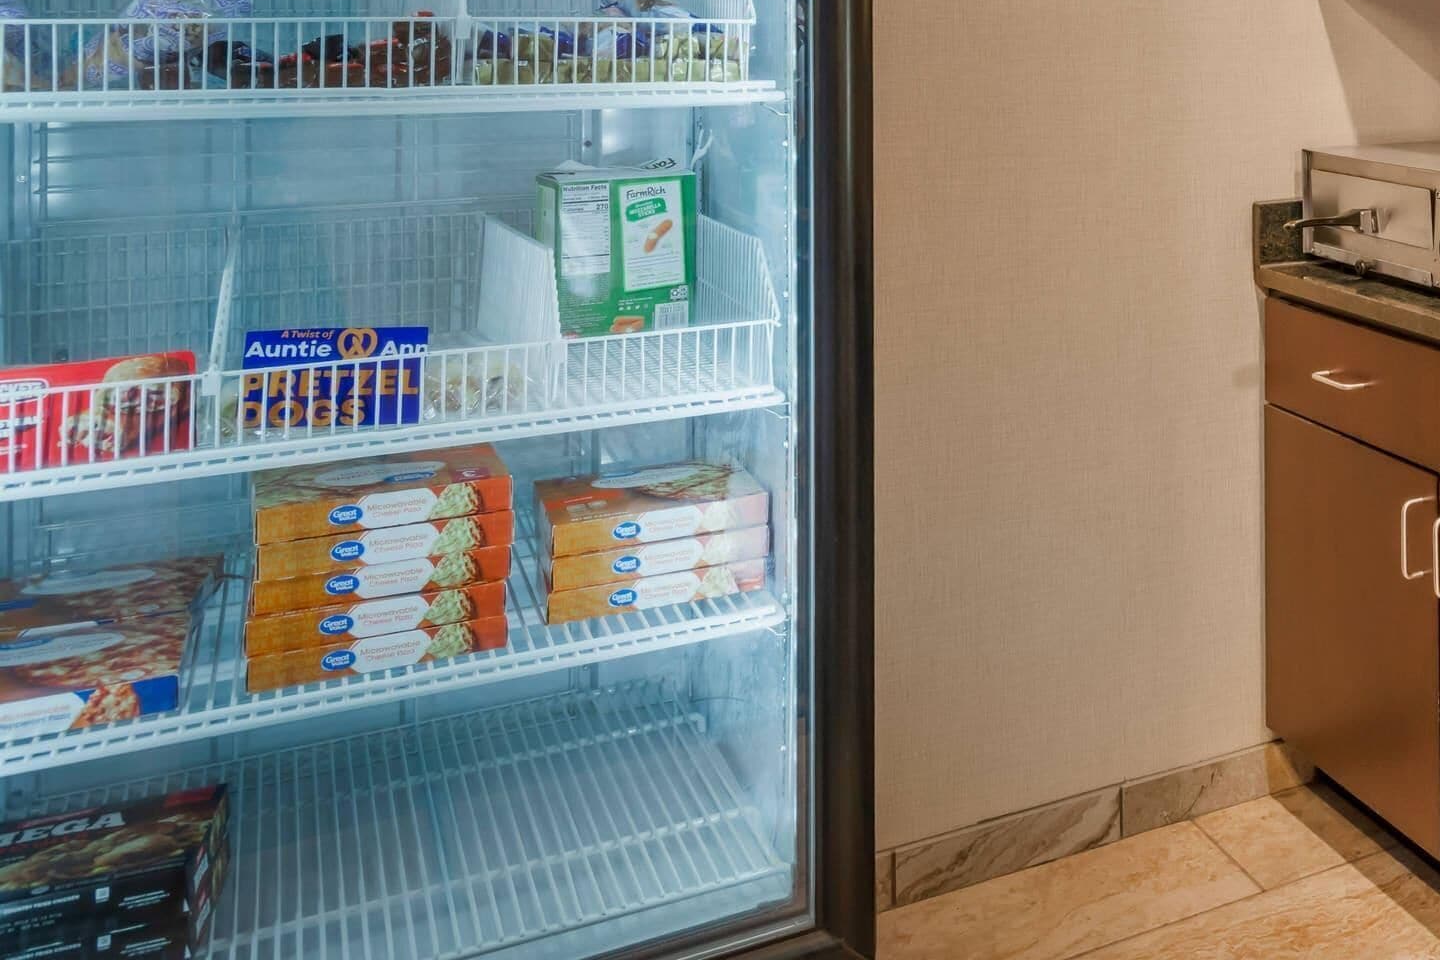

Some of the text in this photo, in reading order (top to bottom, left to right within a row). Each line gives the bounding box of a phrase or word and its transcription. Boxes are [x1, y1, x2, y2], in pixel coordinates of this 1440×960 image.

[281, 329, 335, 339] A Twist of
[245, 340, 333, 358] Auntie
[243, 369, 418, 397] PRETZEL
[242, 399, 366, 428] DOGS
[332, 509, 357, 518] Great
[335, 545, 359, 553] Great
[330, 579, 354, 587] Great
[323, 619, 348, 628] Great
[326, 654, 350, 663] Great
